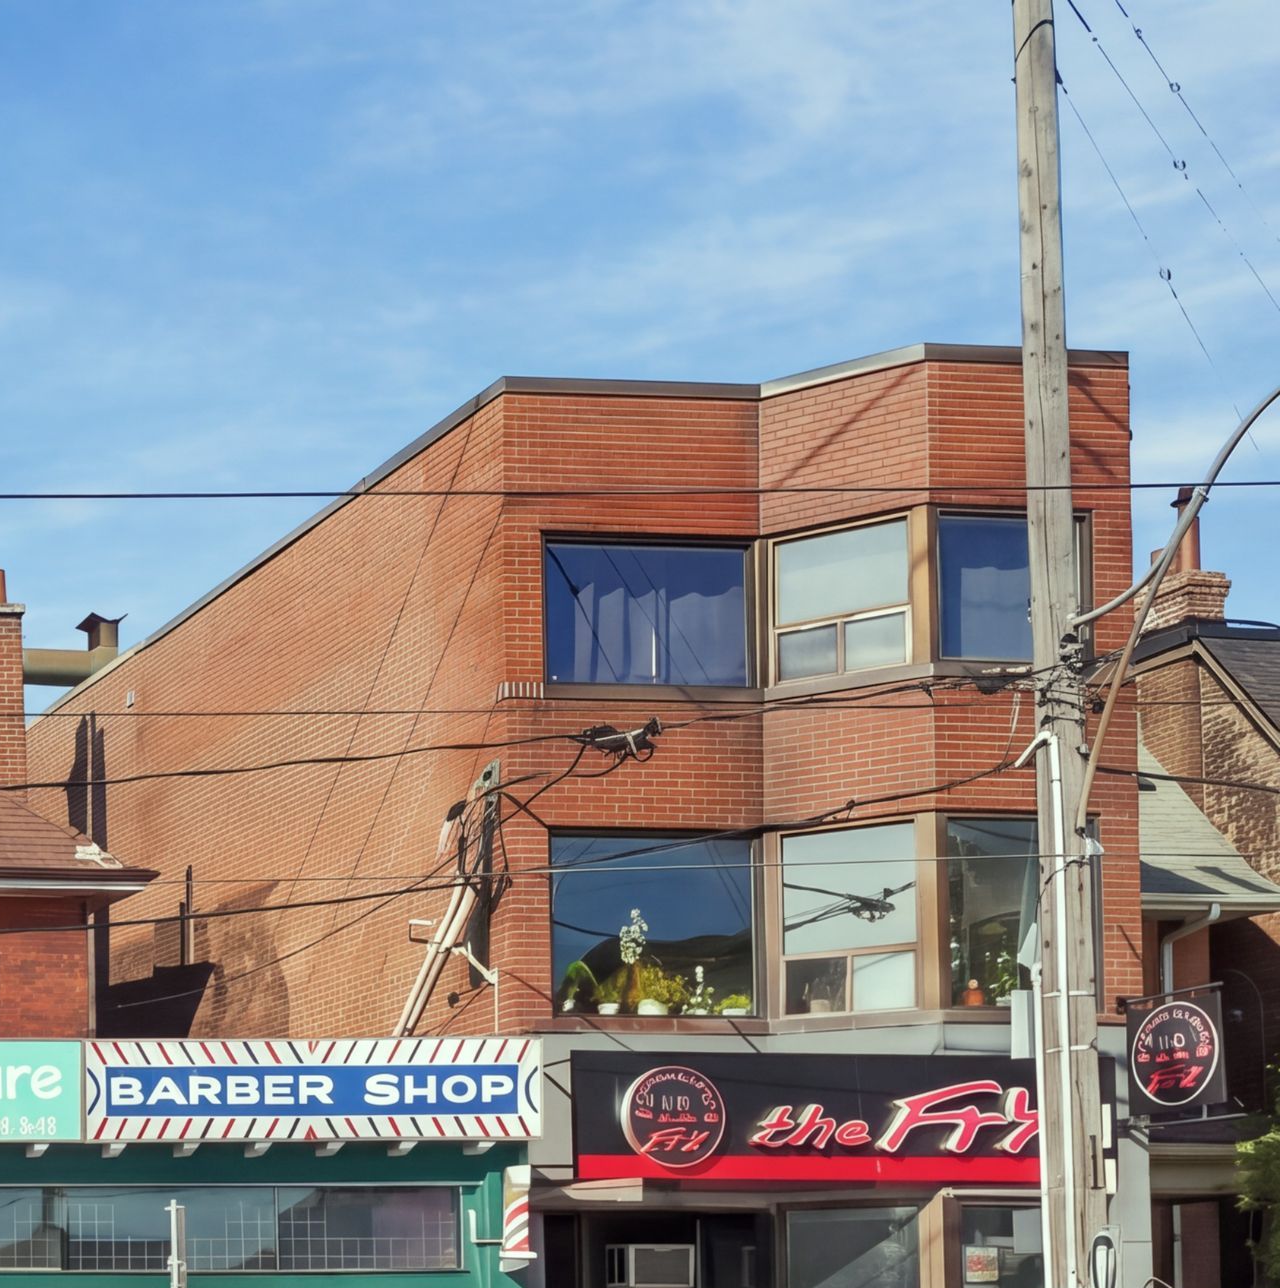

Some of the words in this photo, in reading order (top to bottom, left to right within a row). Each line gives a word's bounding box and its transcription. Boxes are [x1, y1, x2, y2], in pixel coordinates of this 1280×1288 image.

[110, 1075, 335, 1106] BARBER
[363, 1073, 515, 1106] SHOP
[749, 1103, 872, 1149] the
